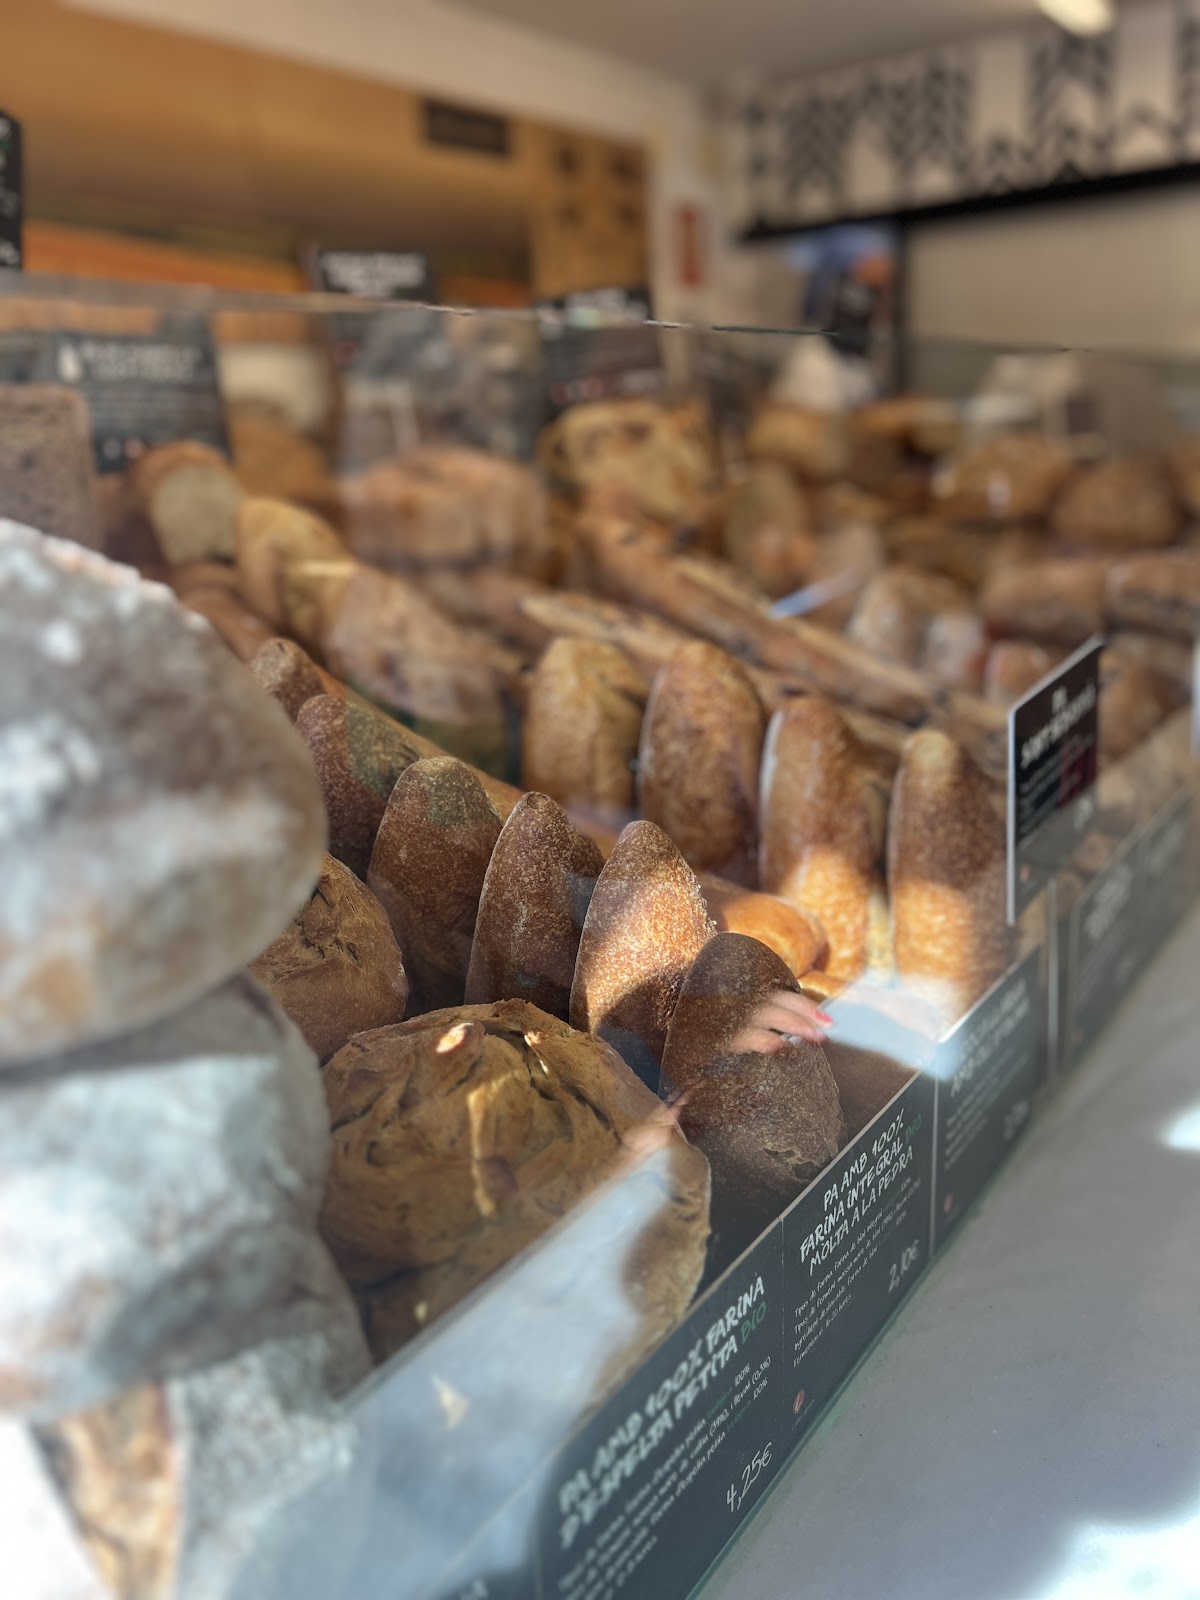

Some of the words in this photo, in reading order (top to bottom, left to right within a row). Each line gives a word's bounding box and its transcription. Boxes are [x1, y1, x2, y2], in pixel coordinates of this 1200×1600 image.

[824, 1183, 838, 1211] PA
[840, 1152, 867, 1192] AMB
[872, 1108, 904, 1156] 100%
[809, 1218, 849, 1276] MÒLTA
[851, 1207, 860, 1227] A
[861, 1188, 876, 1216] LA
[878, 1145, 913, 1197] PEDRA
[645, 1338, 703, 1418] 100%
[734, 1362, 751, 1387] 100%
[753, 1376, 768, 1400] 100%
[727, 1442, 772, 1512] 4,25€
